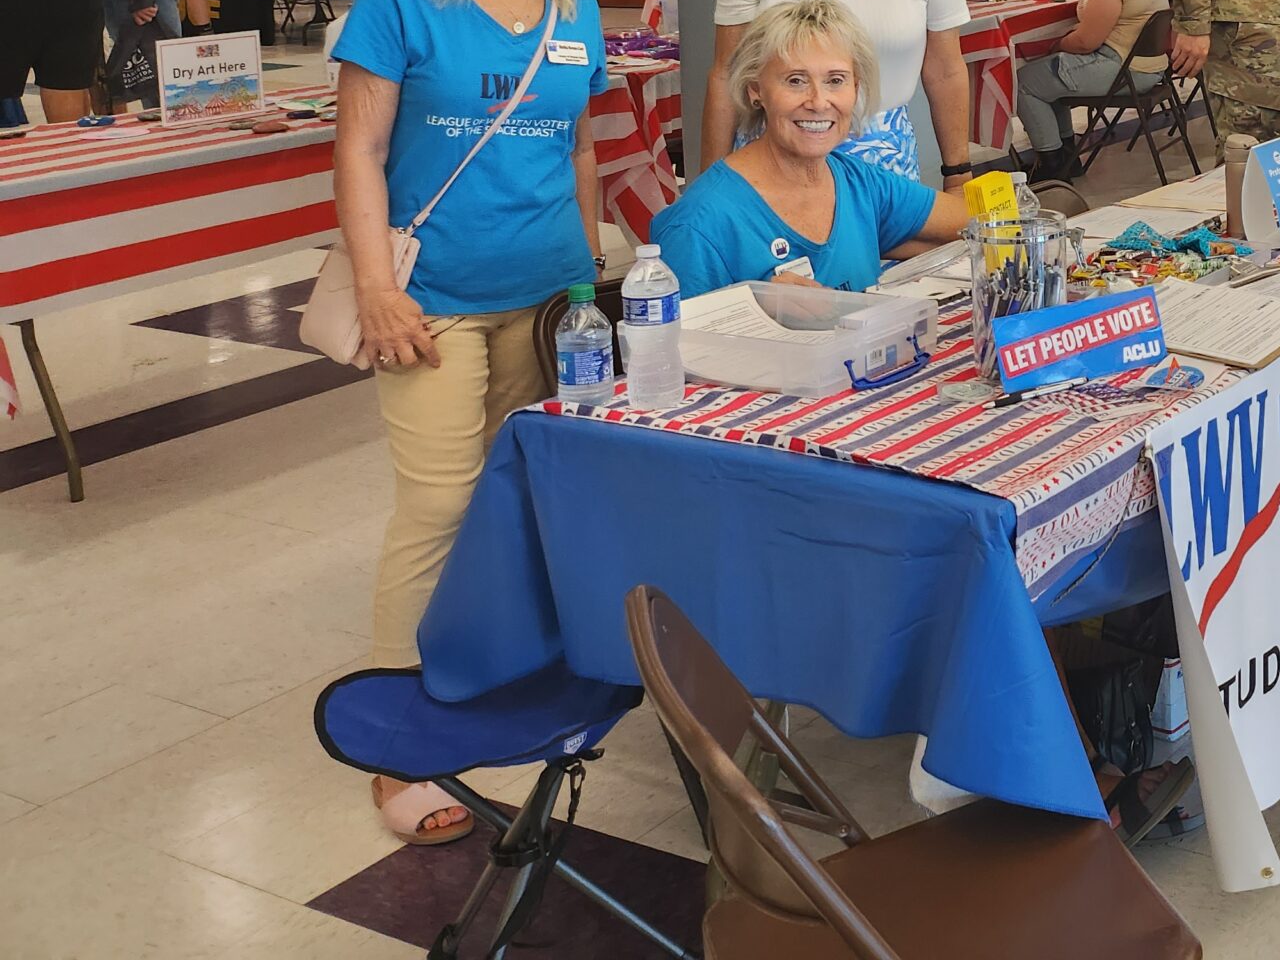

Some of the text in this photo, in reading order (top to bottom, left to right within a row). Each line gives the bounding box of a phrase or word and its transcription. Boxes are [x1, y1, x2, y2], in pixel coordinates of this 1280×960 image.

[173, 61, 247, 80] Dry Art Here
[480, 73, 522, 100] LW
[426, 114, 471, 128] LEAGUE
[485, 118, 532, 127] WMEN
[531, 119, 569, 131] VOTER
[446, 126, 557, 138] OF THE SACE COAST
[1005, 302, 1155, 372] LET PEOPLE VOTE
[1122, 339, 1161, 364] ACLU
[1060, 452, 1109, 481] VOTE
